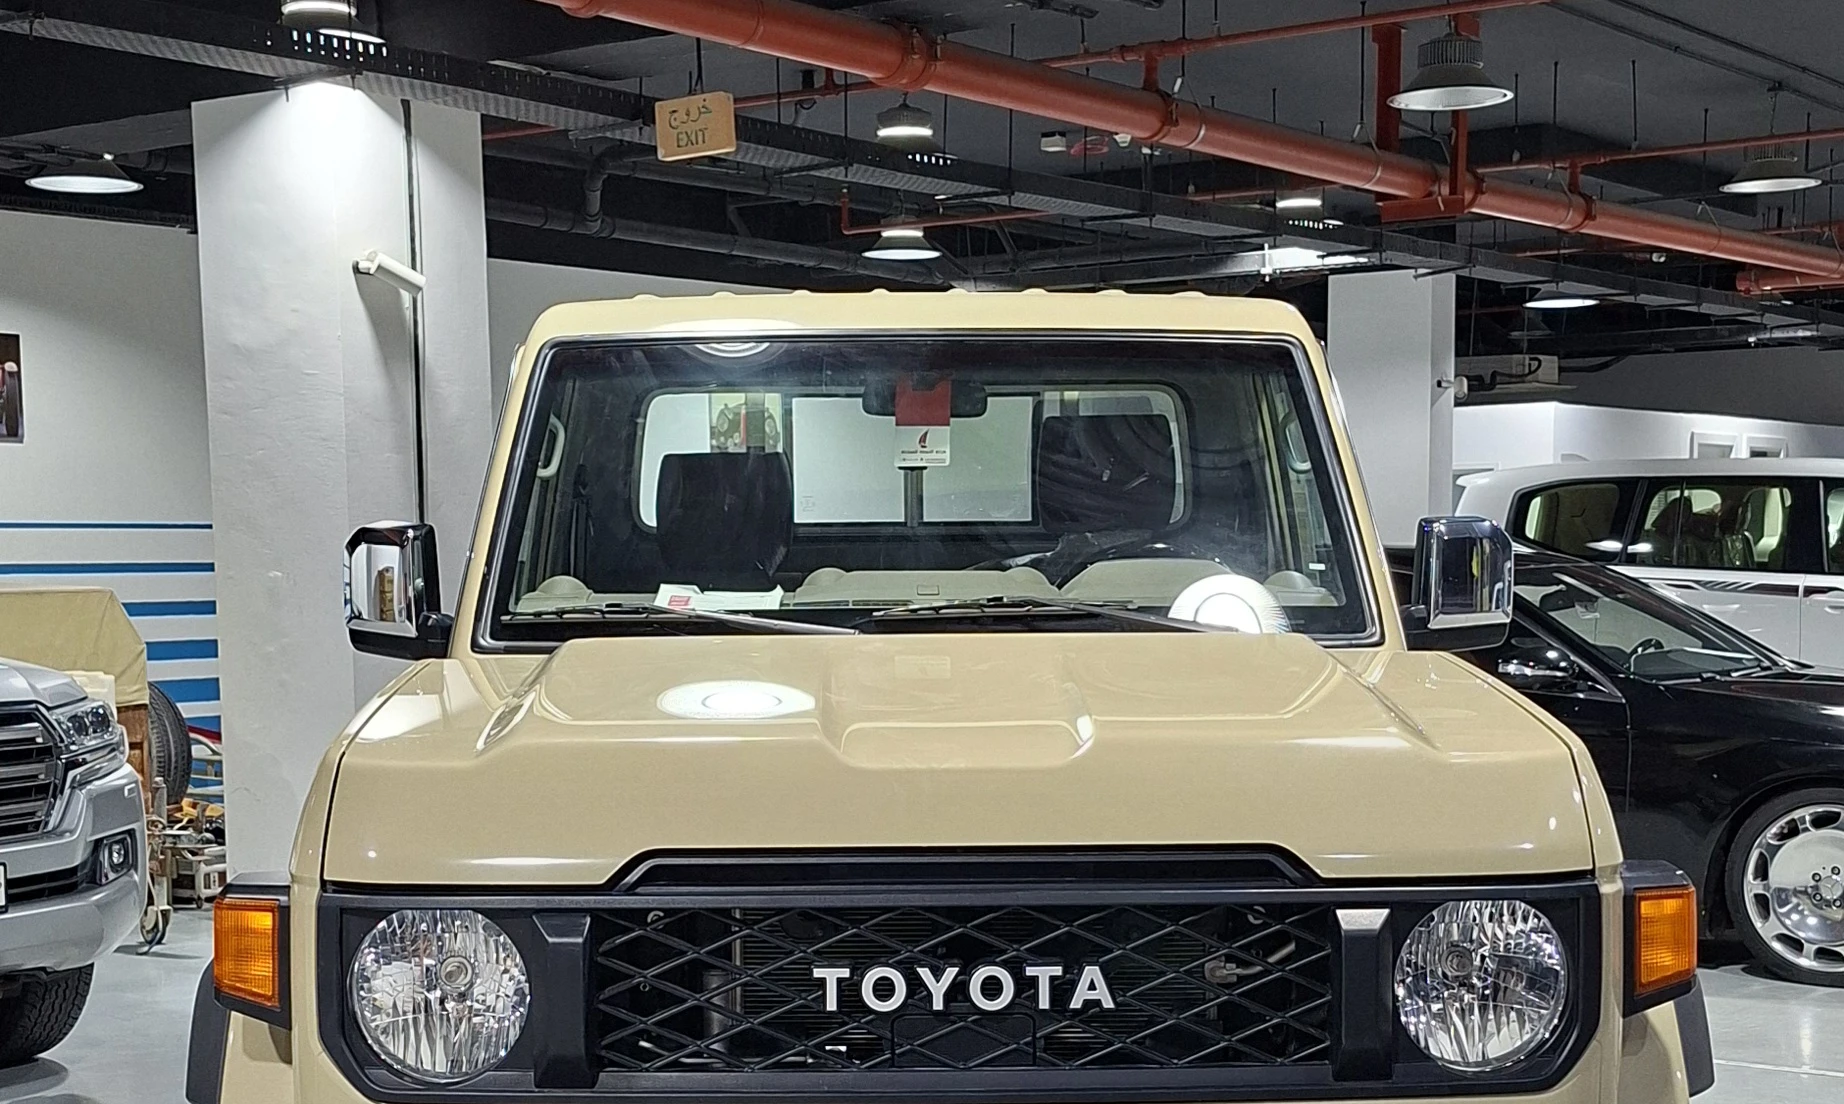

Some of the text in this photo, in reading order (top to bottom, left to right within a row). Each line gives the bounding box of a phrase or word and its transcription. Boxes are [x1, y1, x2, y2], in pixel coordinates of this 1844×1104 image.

[668, 98, 712, 130] خروج
[677, 127, 709, 149] EXIT
[812, 965, 1116, 1012] TOYOTA
